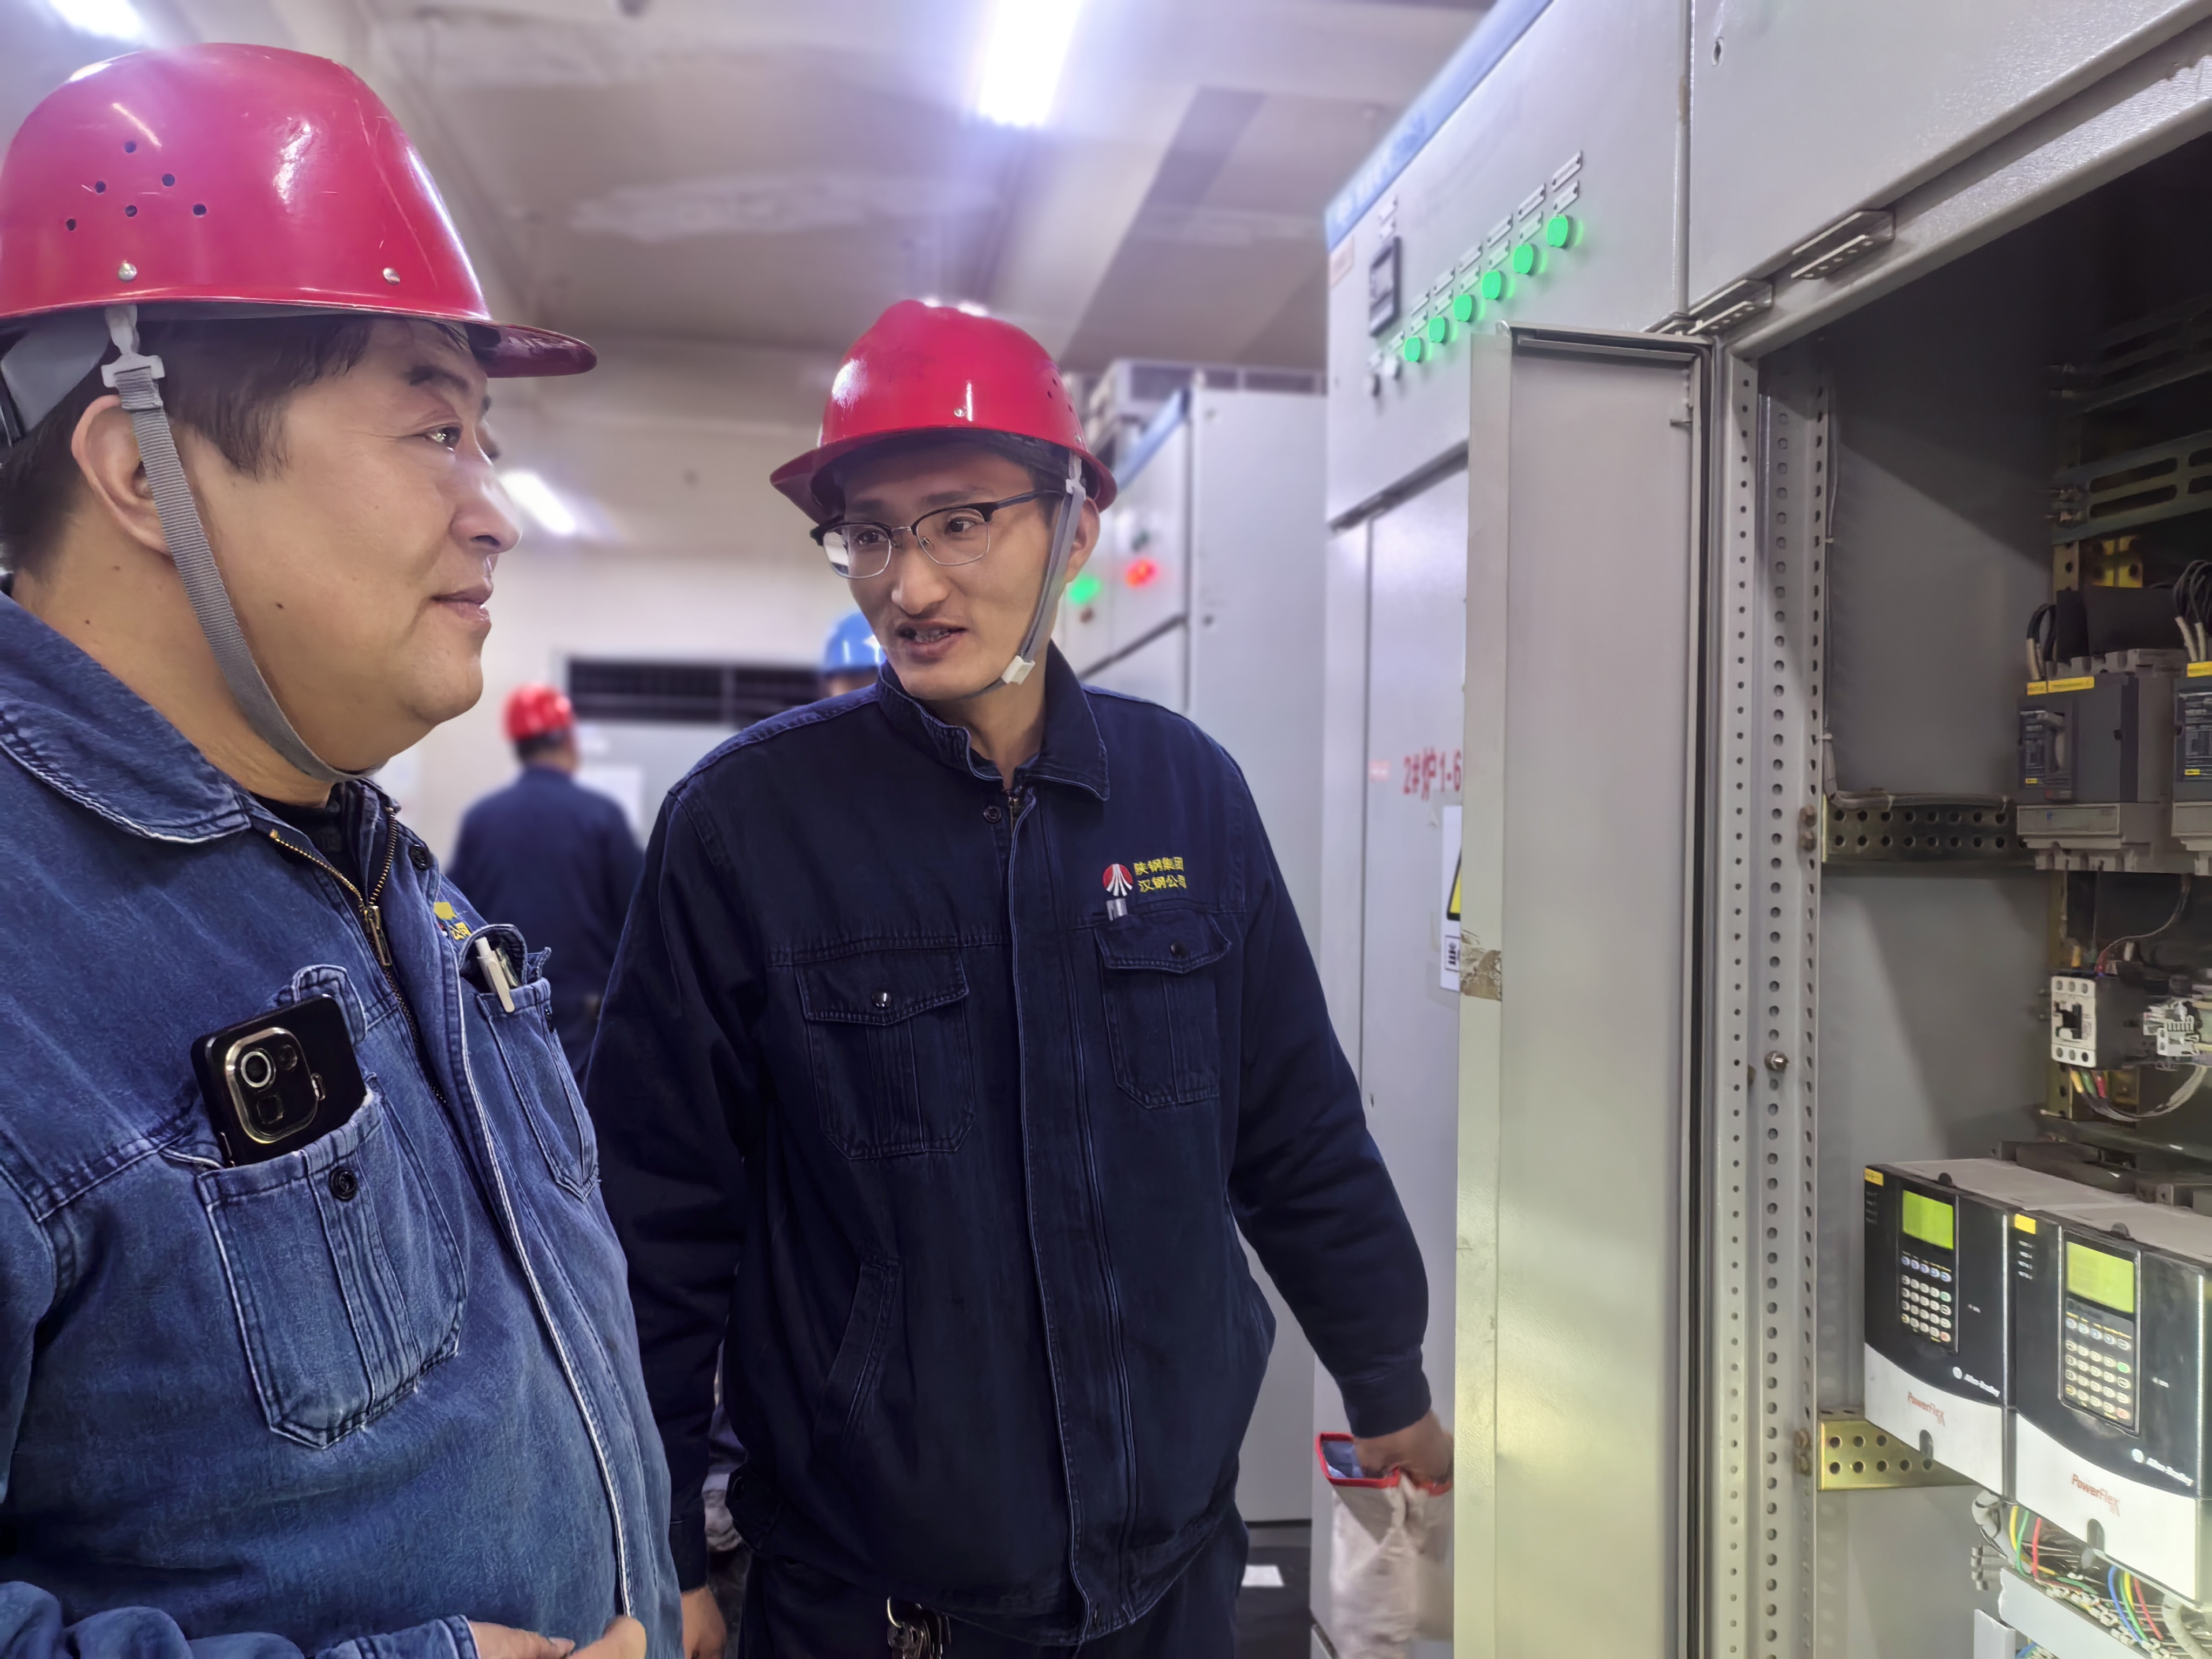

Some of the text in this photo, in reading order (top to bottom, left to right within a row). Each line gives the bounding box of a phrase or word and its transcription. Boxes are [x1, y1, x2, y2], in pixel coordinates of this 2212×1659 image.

[1134, 857, 1184, 875] 陕钢集团
[1137, 875, 1186, 892] 汉钢公司
[2071, 1473, 2120, 1516] PowerFlex
